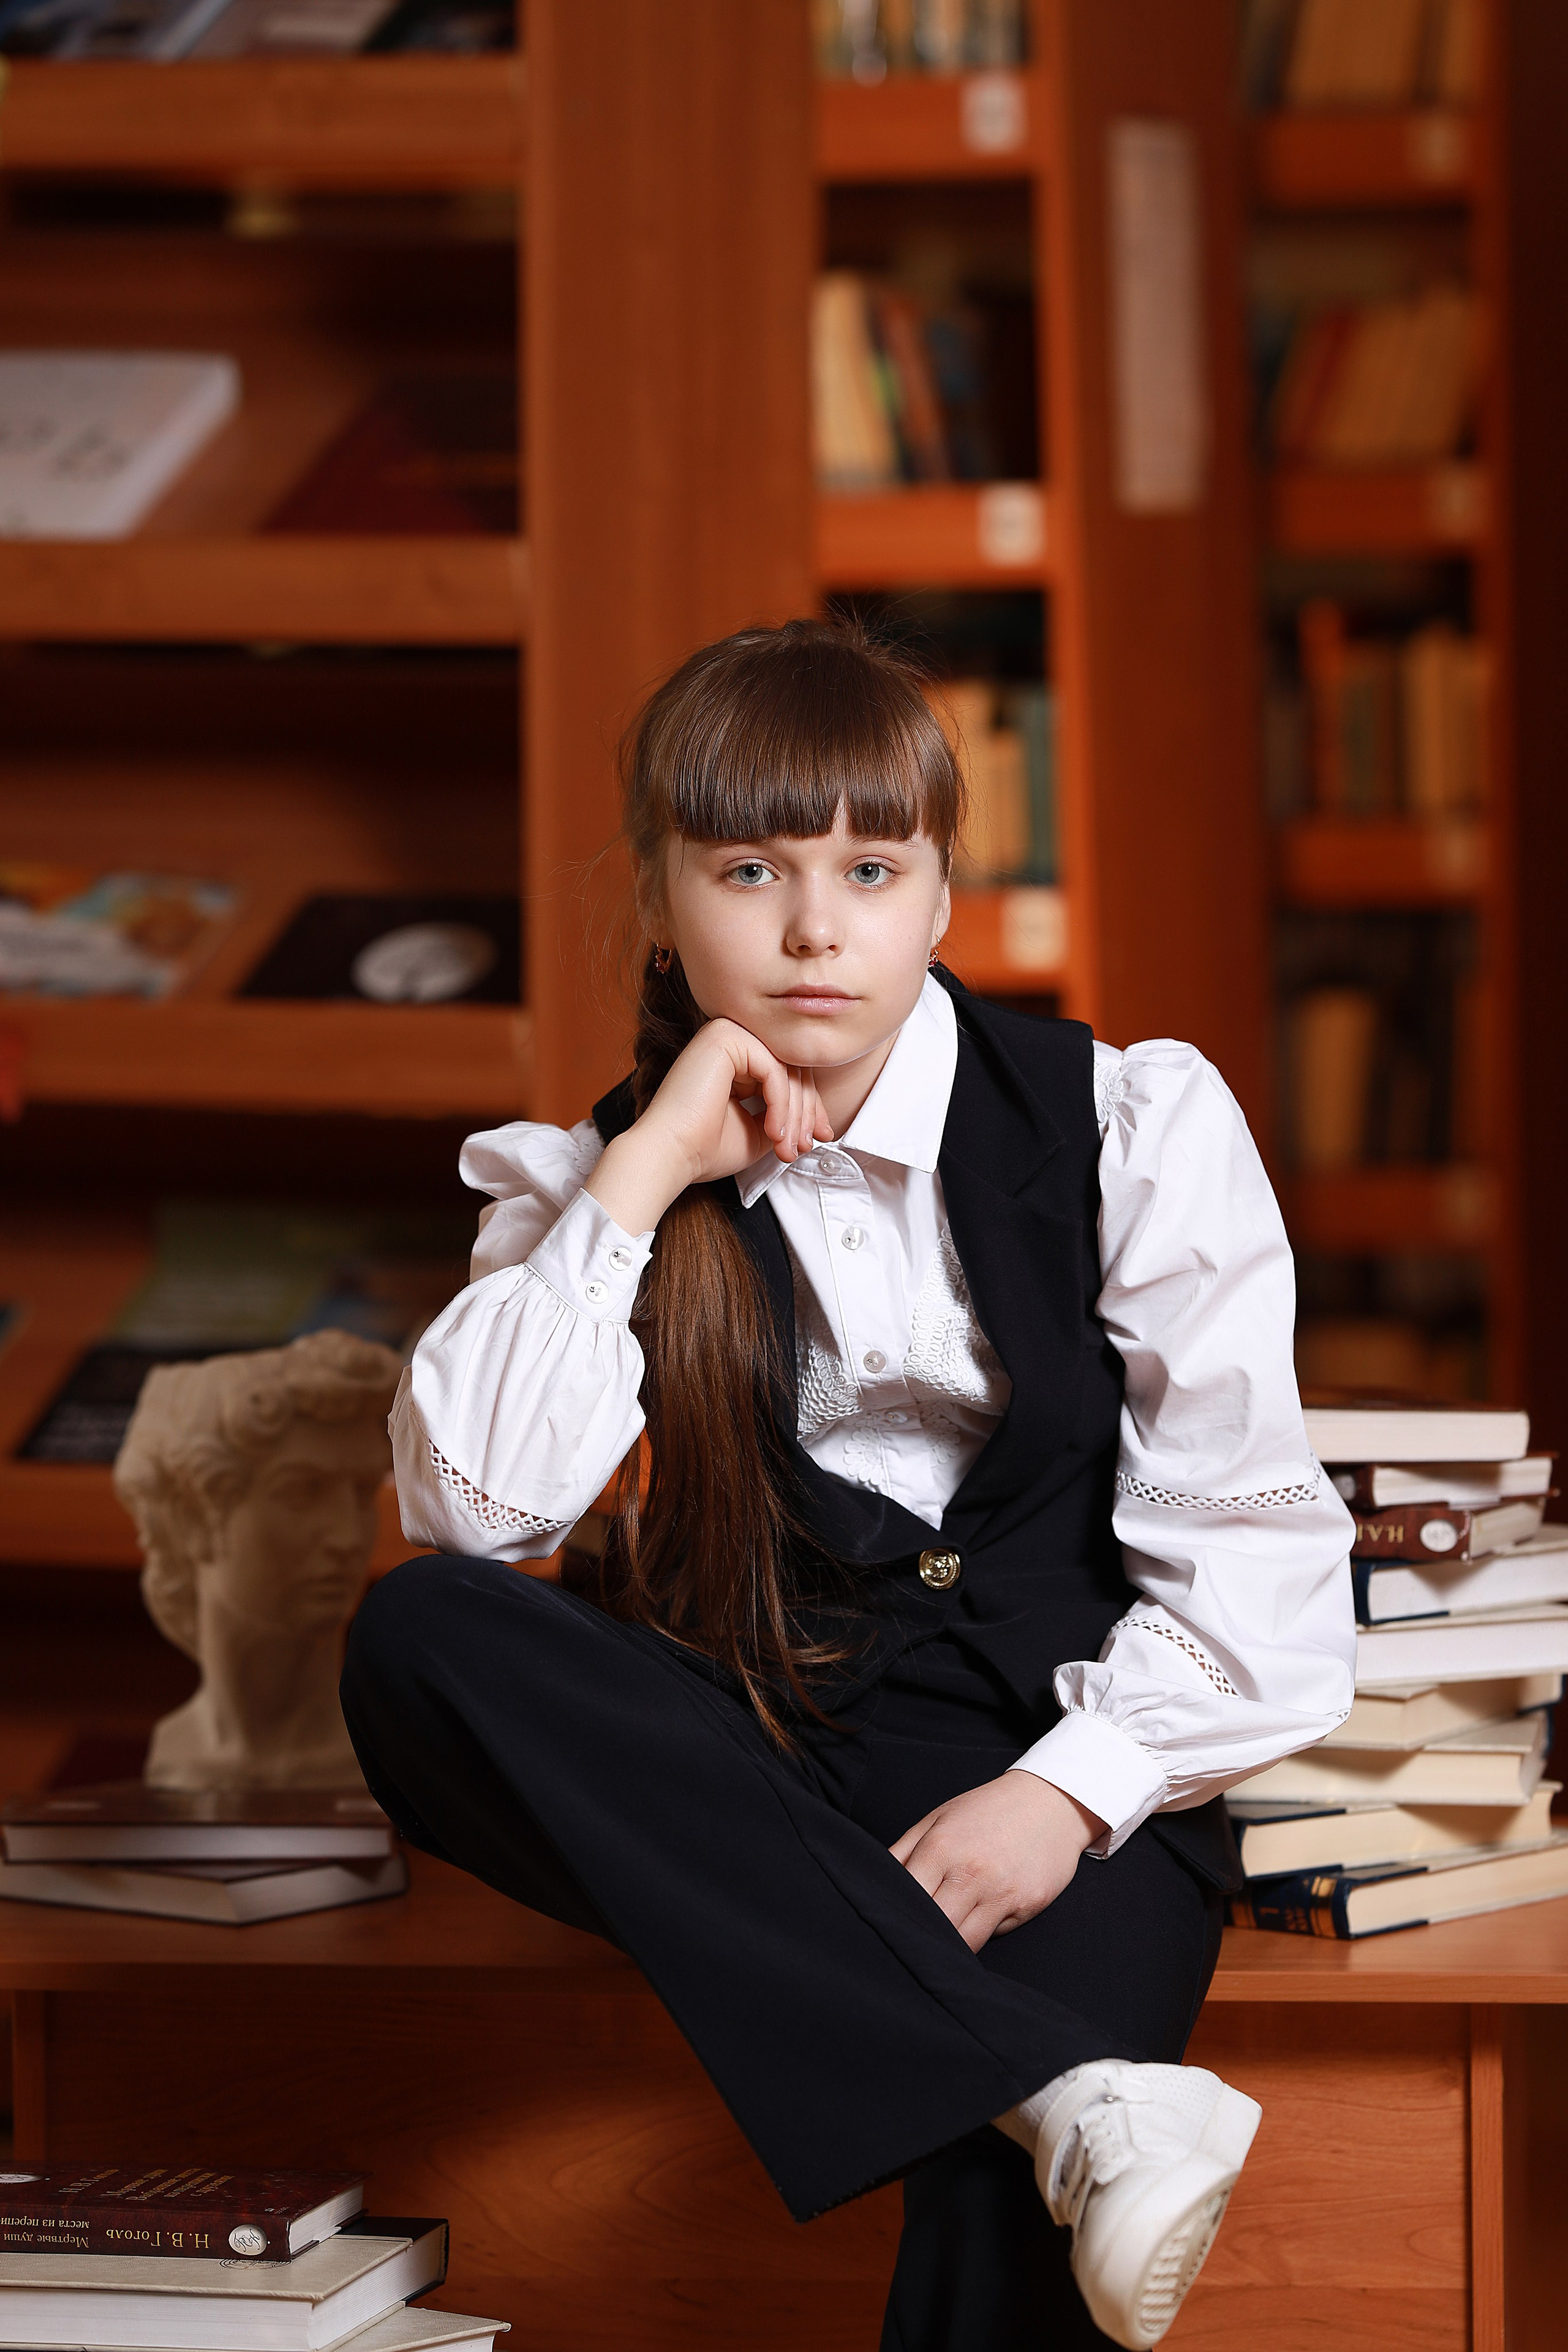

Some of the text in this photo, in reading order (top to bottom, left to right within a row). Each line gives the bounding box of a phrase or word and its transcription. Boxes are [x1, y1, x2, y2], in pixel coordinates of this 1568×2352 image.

[0, 2215, 39, 2226] перепи
[59, 2220, 89, 2228] места
[4, 2231, 89, 2248] Мертвые души
[106, 2229, 209, 2248] Н. В. Гоголь
